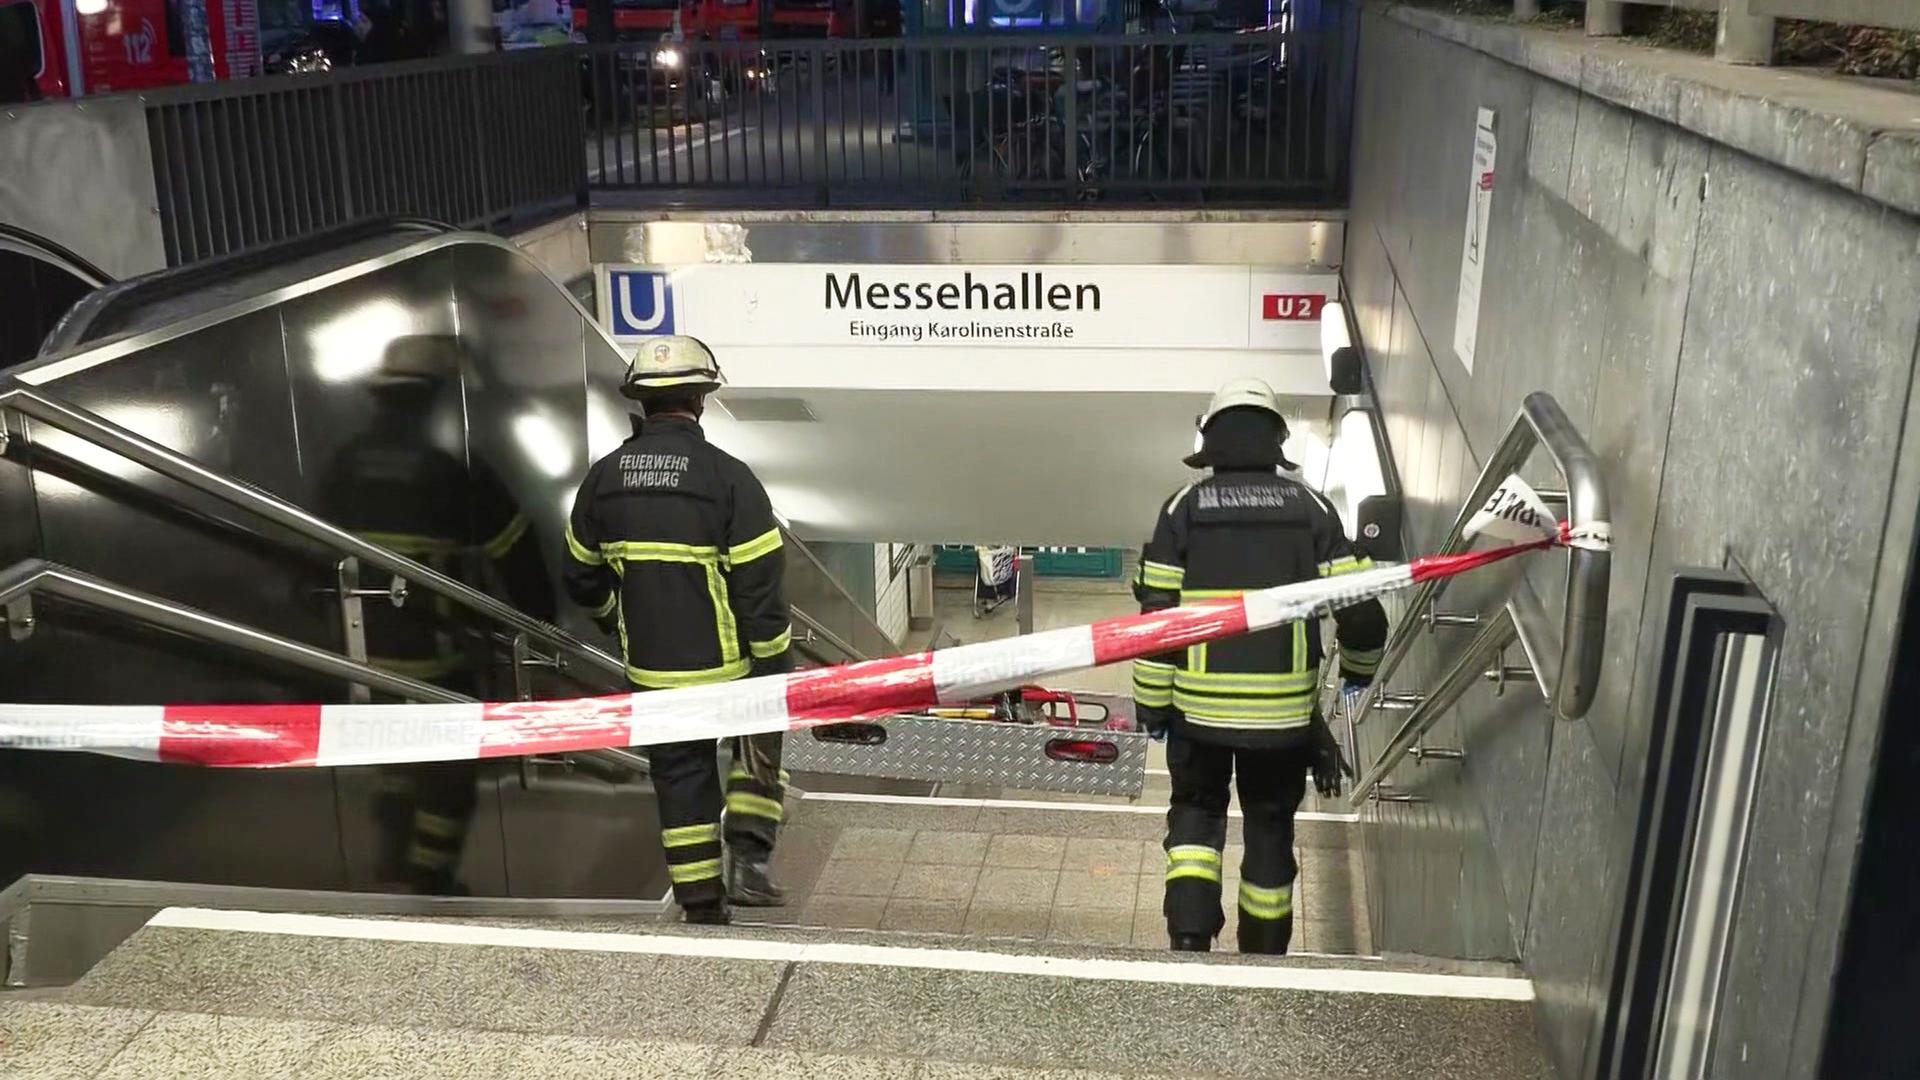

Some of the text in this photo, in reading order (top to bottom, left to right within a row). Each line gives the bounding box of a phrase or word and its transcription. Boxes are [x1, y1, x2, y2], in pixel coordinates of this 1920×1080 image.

[123, 33, 152, 64] 112
[618, 275, 666, 331] U
[824, 271, 1101, 312] Messehallen
[850, 321, 1074, 341] Eingang Karolinenstraße
[619, 454, 690, 472] FEUERWEHR
[623, 470, 681, 488] HAMBURG
